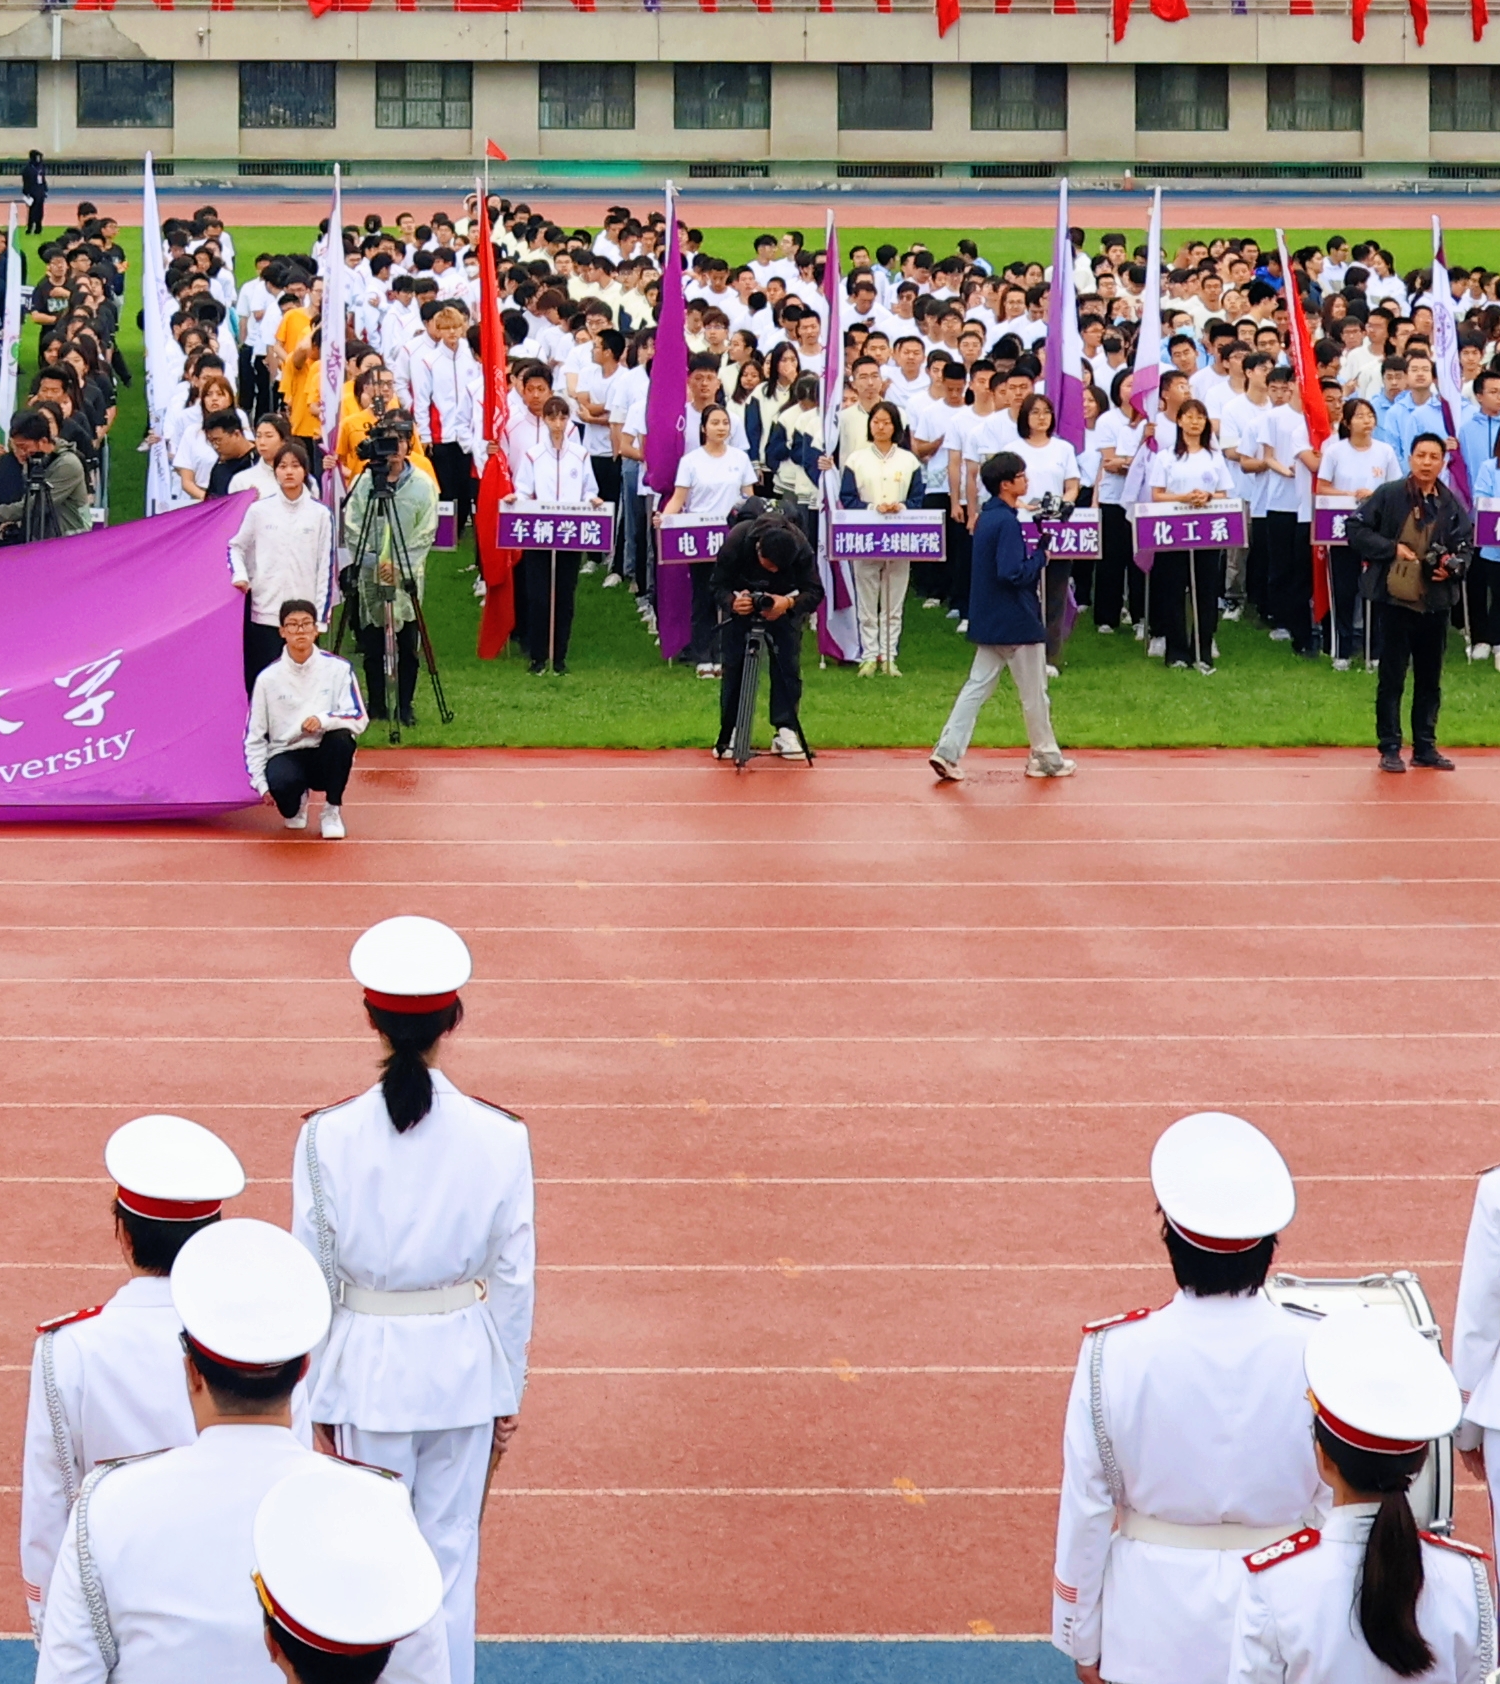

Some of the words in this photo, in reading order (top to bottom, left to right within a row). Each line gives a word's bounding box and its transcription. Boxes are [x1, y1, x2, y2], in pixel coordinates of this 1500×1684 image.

[510, 517, 602, 545] 车辆学院
[1153, 517, 1230, 546] 化工系
